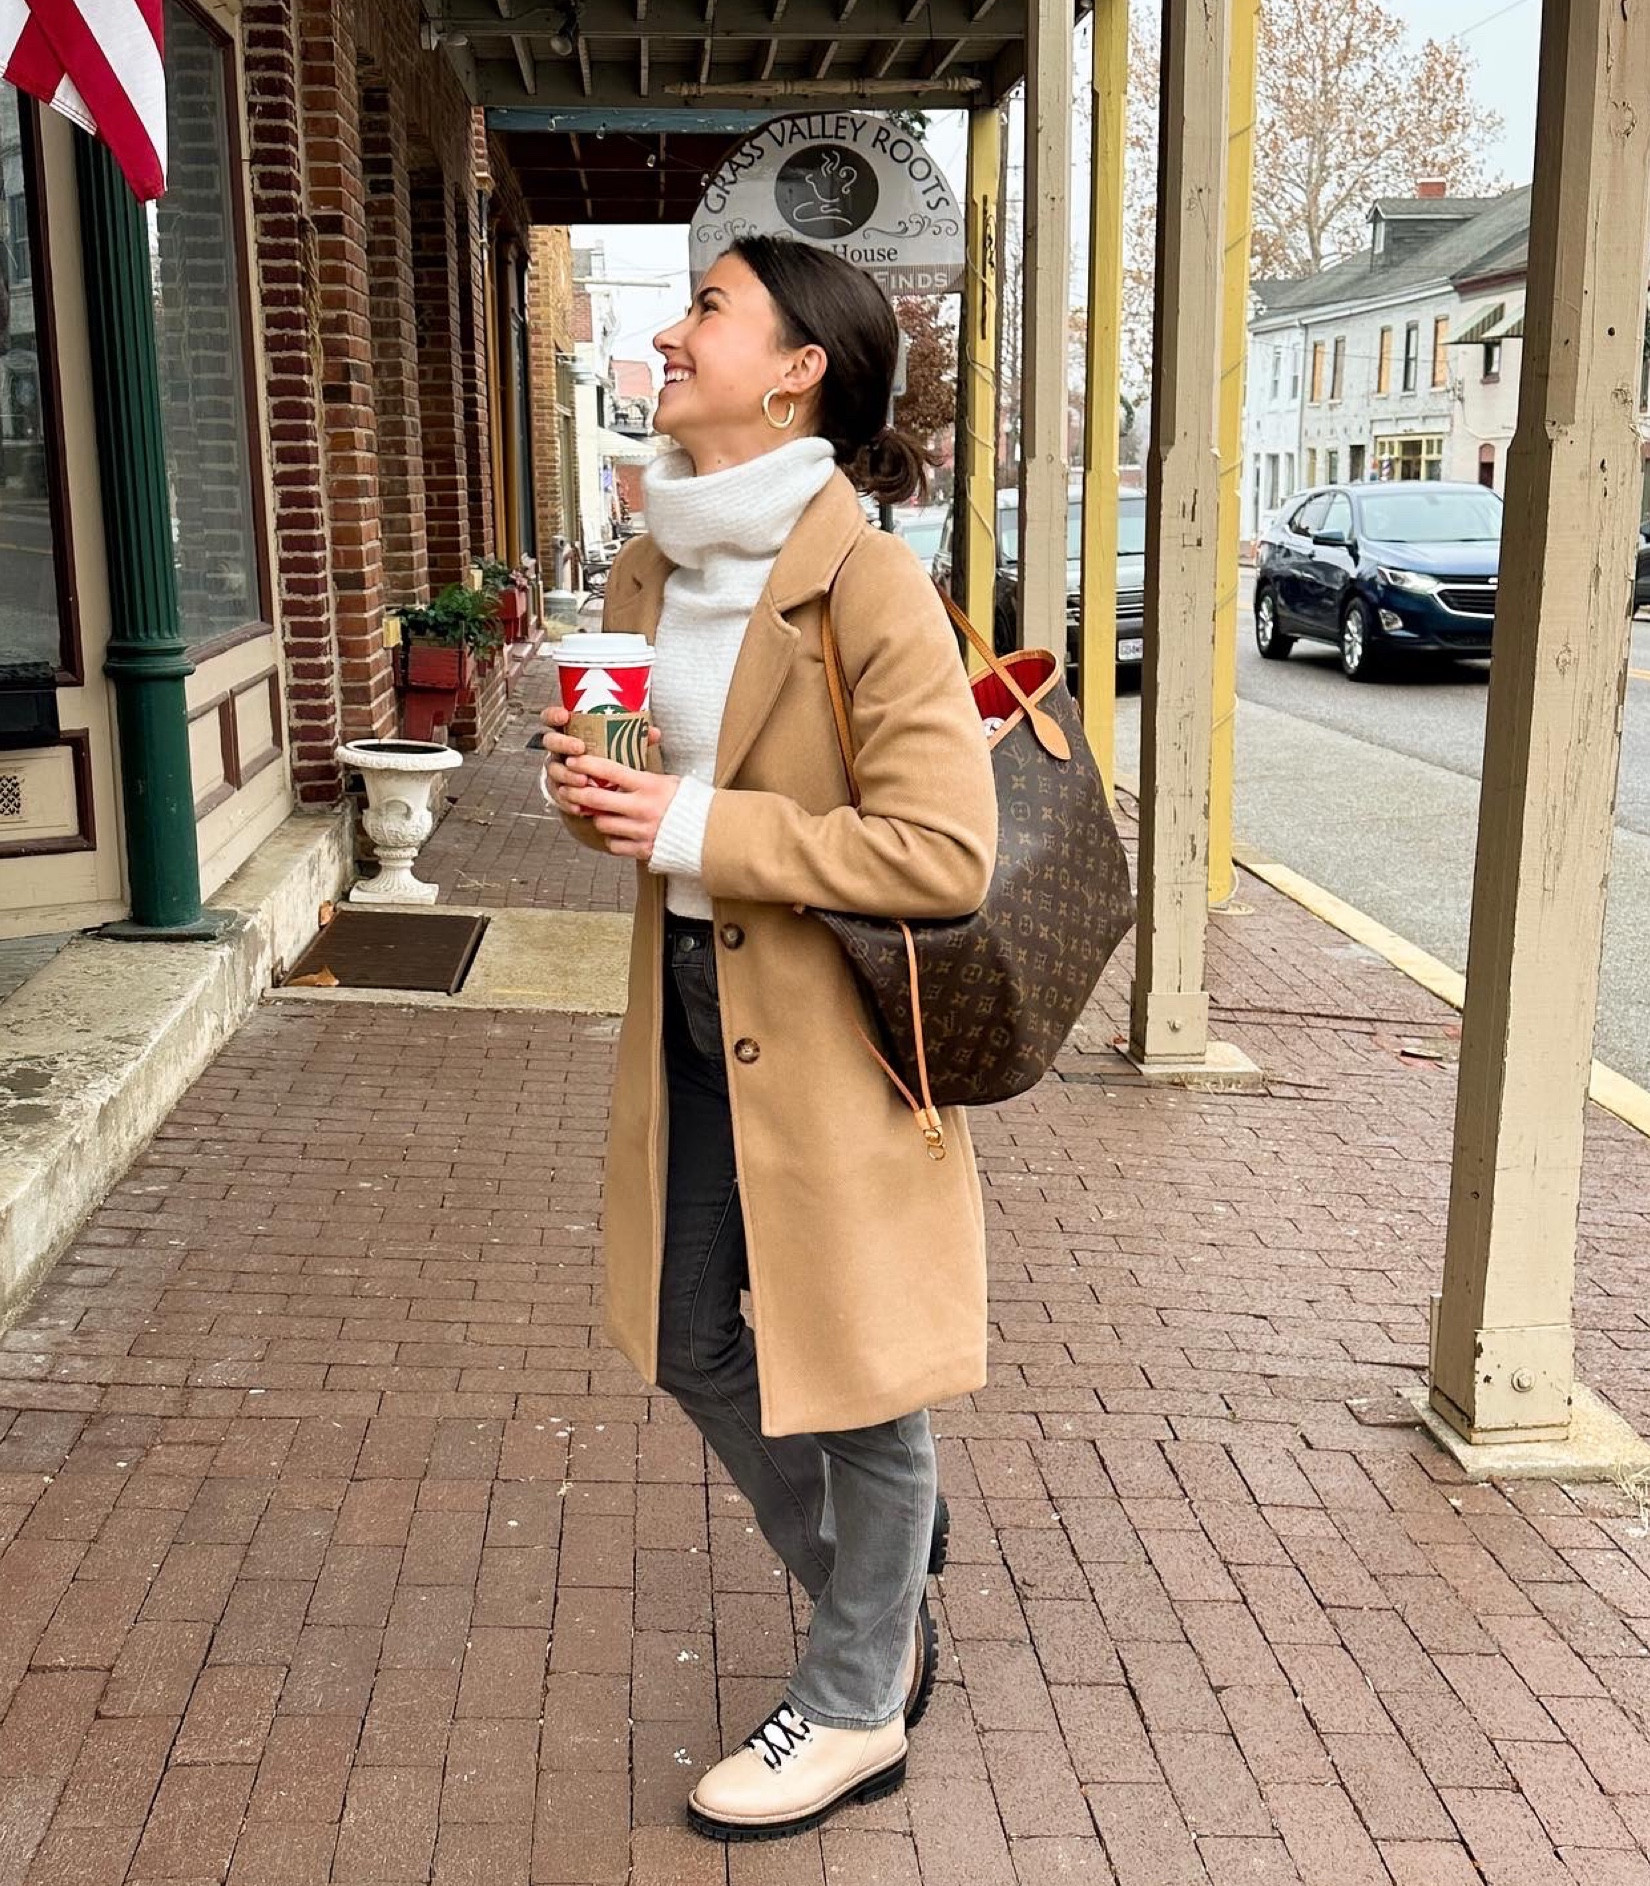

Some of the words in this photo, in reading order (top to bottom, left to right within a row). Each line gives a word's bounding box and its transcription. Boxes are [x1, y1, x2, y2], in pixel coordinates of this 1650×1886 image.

[704, 140, 765, 214] GRASS
[766, 113, 868, 148] VALLEY
[872, 126, 950, 211] ROOTS
[832, 243, 899, 263] House
[873, 270, 948, 289] FINDS
